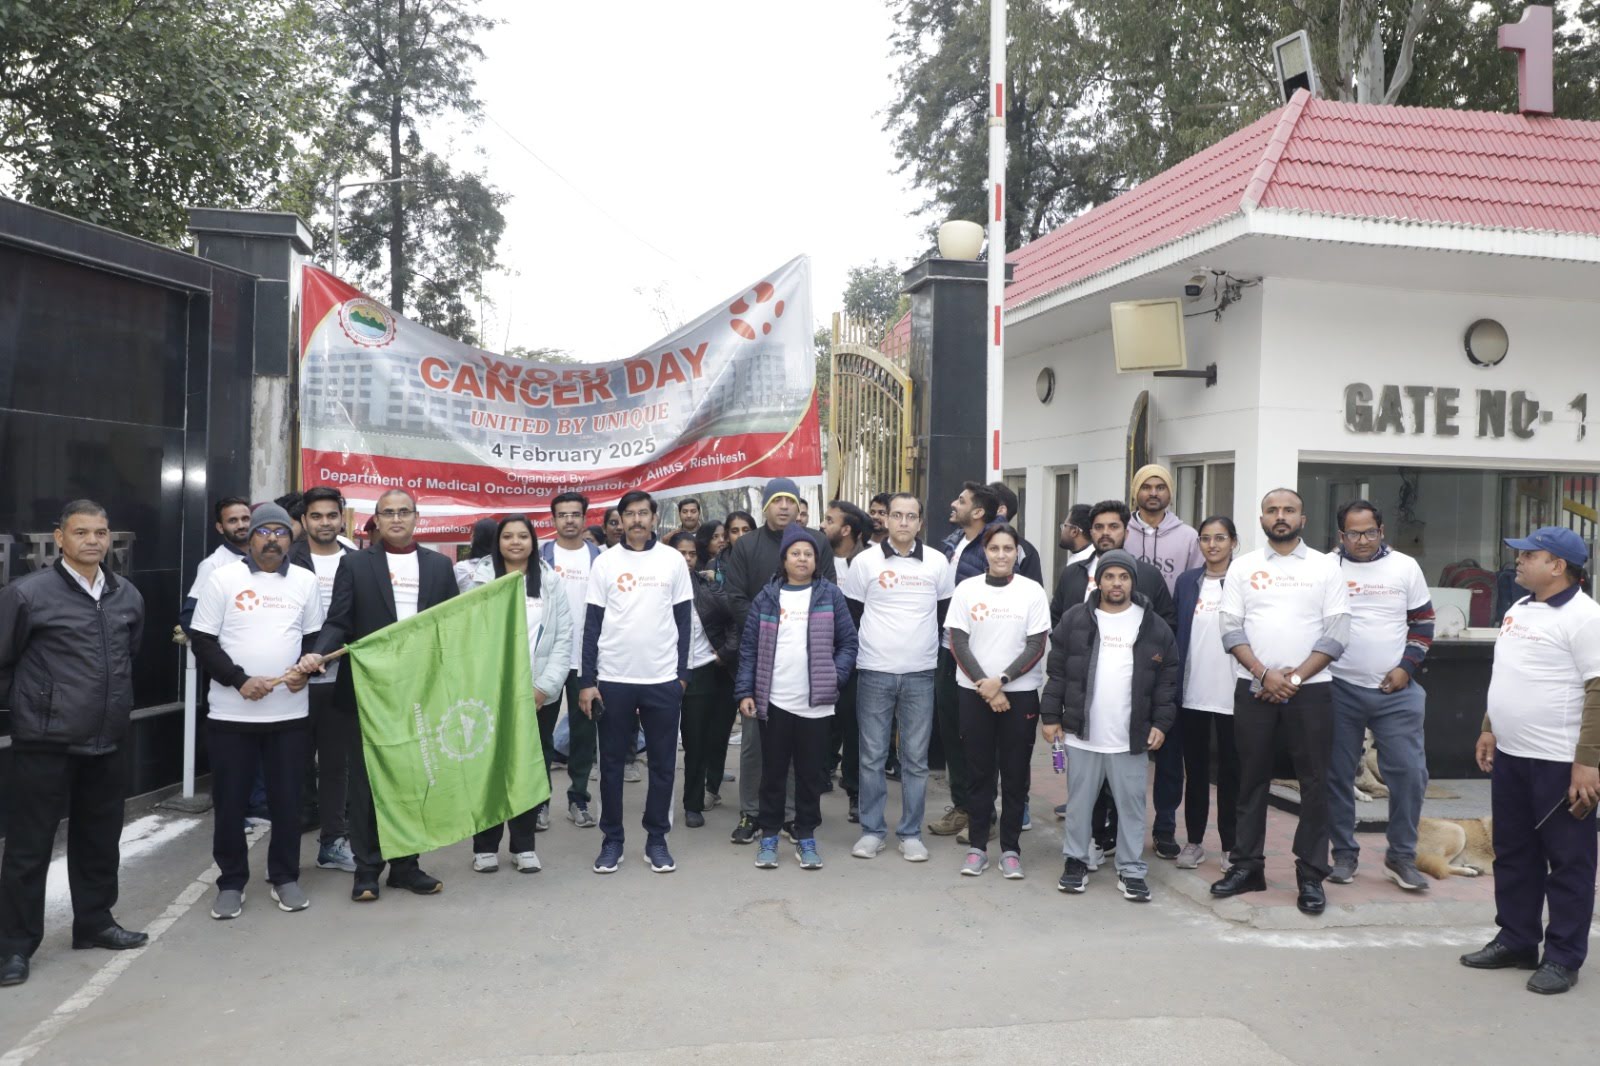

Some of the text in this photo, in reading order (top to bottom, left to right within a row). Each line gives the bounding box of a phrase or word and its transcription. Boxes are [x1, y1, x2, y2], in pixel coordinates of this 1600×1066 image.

[1497, 4, 1553, 115] 1
[419, 342, 709, 407] CANCER DAY
[481, 355, 607, 381] WOR
[471, 402, 669, 435] UNITED BY UNIQUE
[1344, 382, 1460, 436] GATE
[491, 442, 503, 458] 4
[510, 445, 601, 464] February
[609, 438, 656, 459] 2025
[320, 468, 403, 487] Department
[407, 478, 422, 488] of
[426, 477, 480, 492] Medical
[485, 483, 552, 497] Oncology
[690, 450, 747, 469] Rishikesh
[507, 472, 566, 484] Organized
